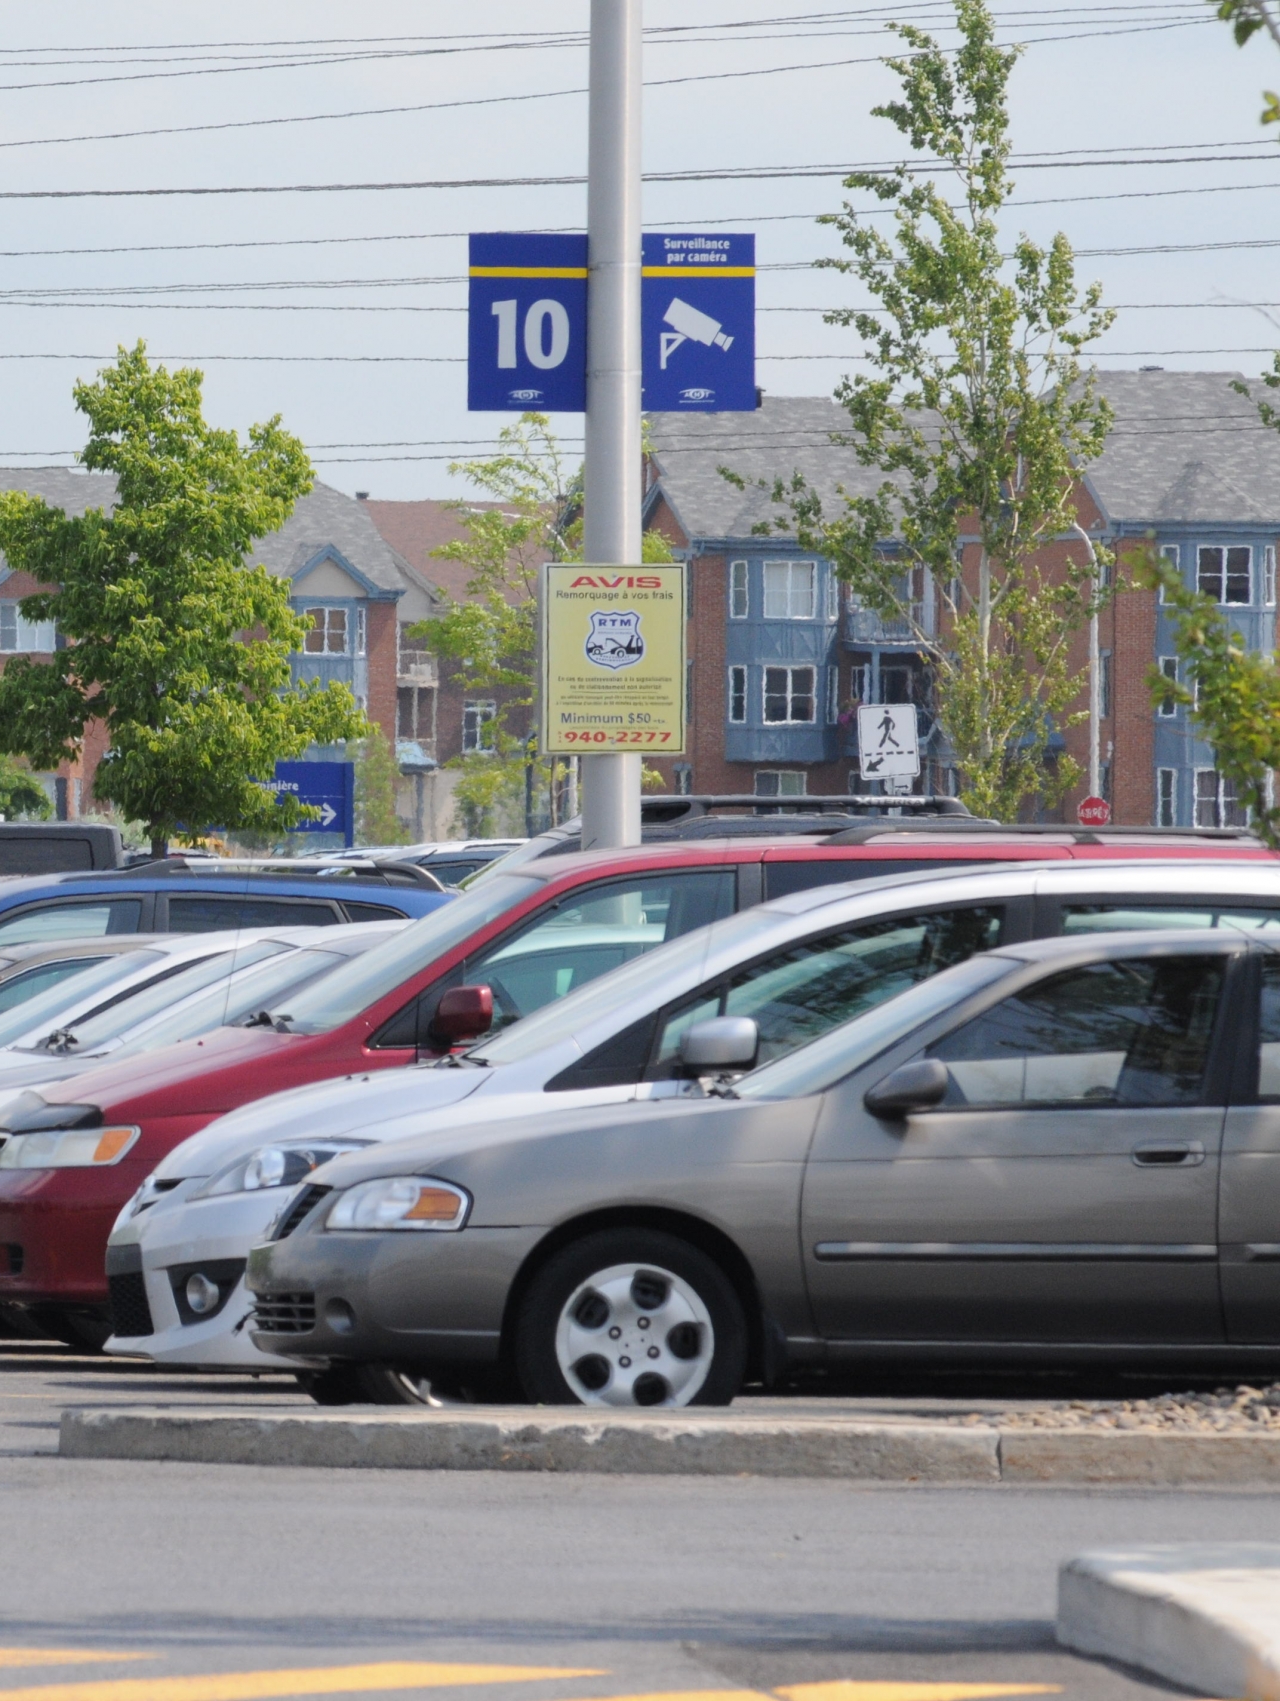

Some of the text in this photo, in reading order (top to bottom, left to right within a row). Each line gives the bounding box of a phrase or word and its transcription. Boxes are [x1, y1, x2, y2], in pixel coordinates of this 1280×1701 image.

[663, 237, 730, 249] Surveillance
[667, 251, 727, 264] par caméra
[491, 299, 569, 370] 10
[569, 576, 662, 589] AVIS
[556, 590, 674, 601] Remorquage à vos frais
[598, 618, 632, 627] RTM
[561, 712, 624, 724] Minimum
[628, 712, 651, 725] $50
[564, 731, 672, 743] 940-2277
